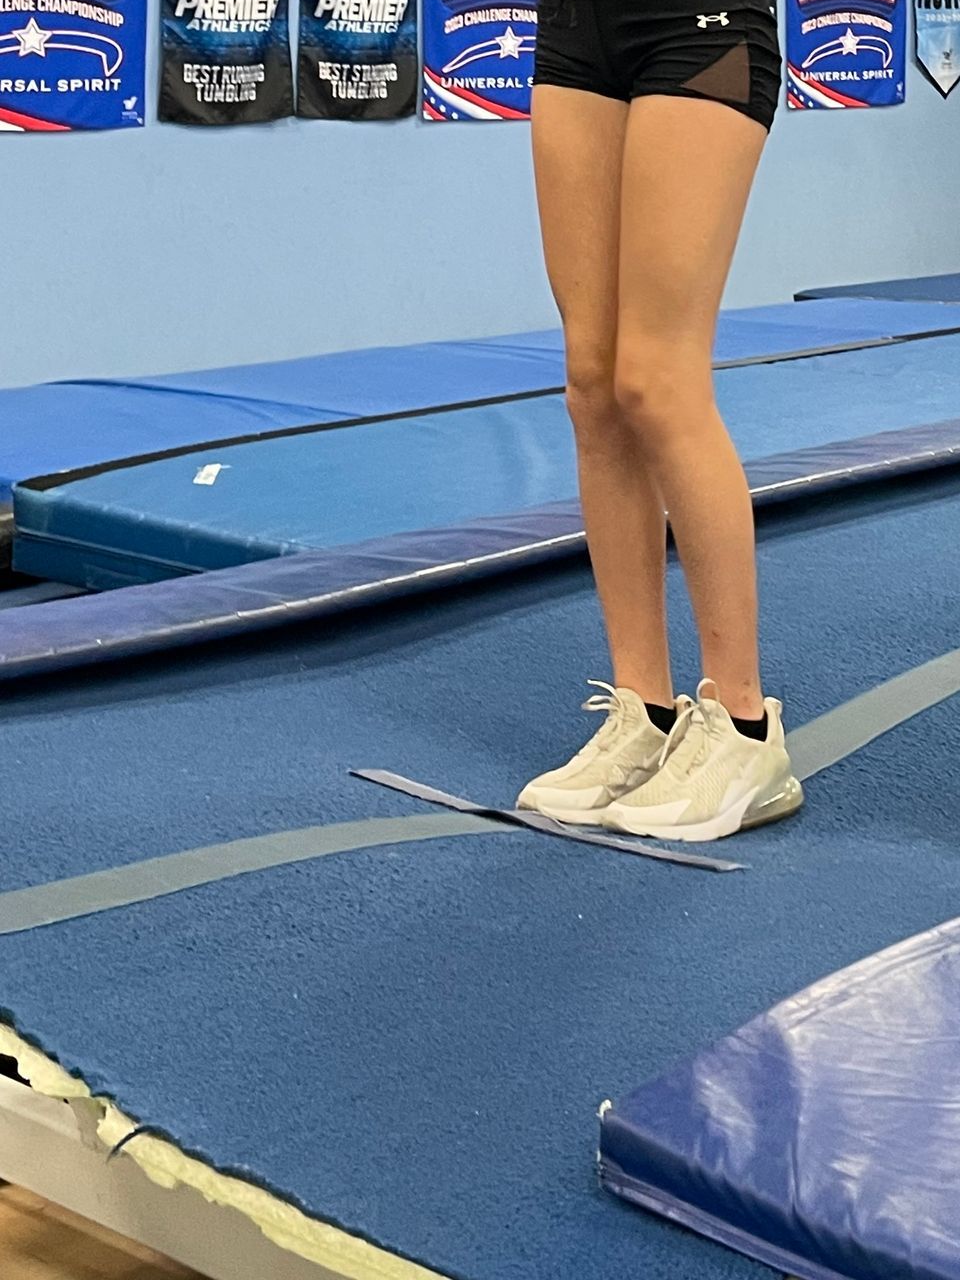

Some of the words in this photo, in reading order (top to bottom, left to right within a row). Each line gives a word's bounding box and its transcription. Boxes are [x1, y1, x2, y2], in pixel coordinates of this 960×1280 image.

[184, 63, 220, 83] BEST
[318, 61, 351, 81] BEST
[57, 78, 121, 92] SPIRIT
[440, 77, 523, 90] UNIVERSAL
